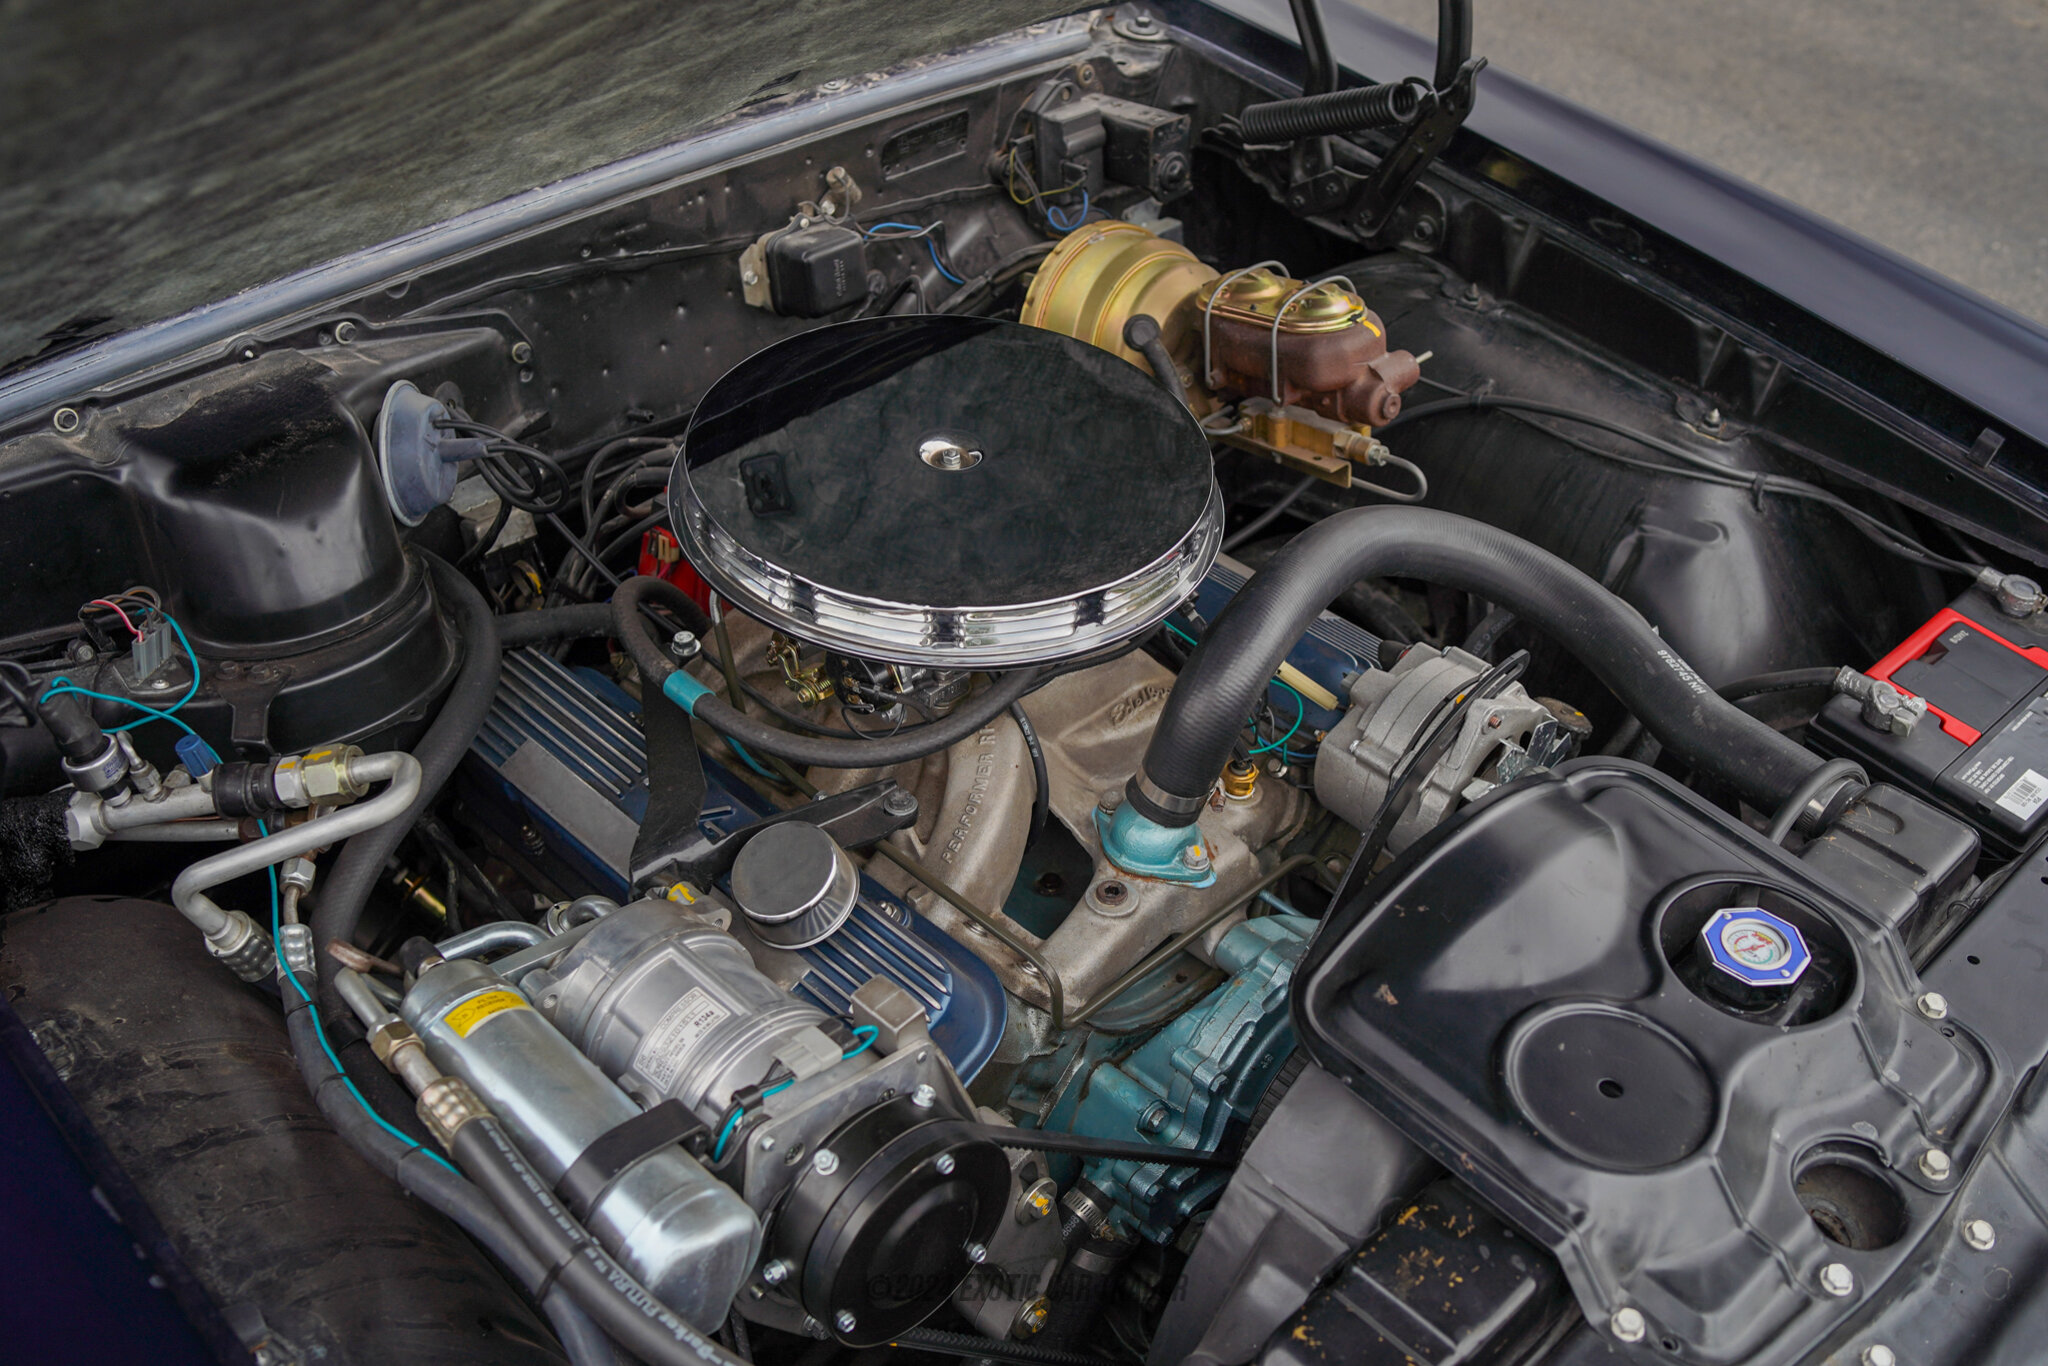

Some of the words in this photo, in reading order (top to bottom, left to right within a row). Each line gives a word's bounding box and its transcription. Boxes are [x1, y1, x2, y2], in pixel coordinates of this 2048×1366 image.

[1687, 680, 1706, 694] NH
[940, 753, 994, 864] PERFORMER
[693, 1007, 715, 1028] R134a
[607, 1268, 661, 1318] FUTURA
